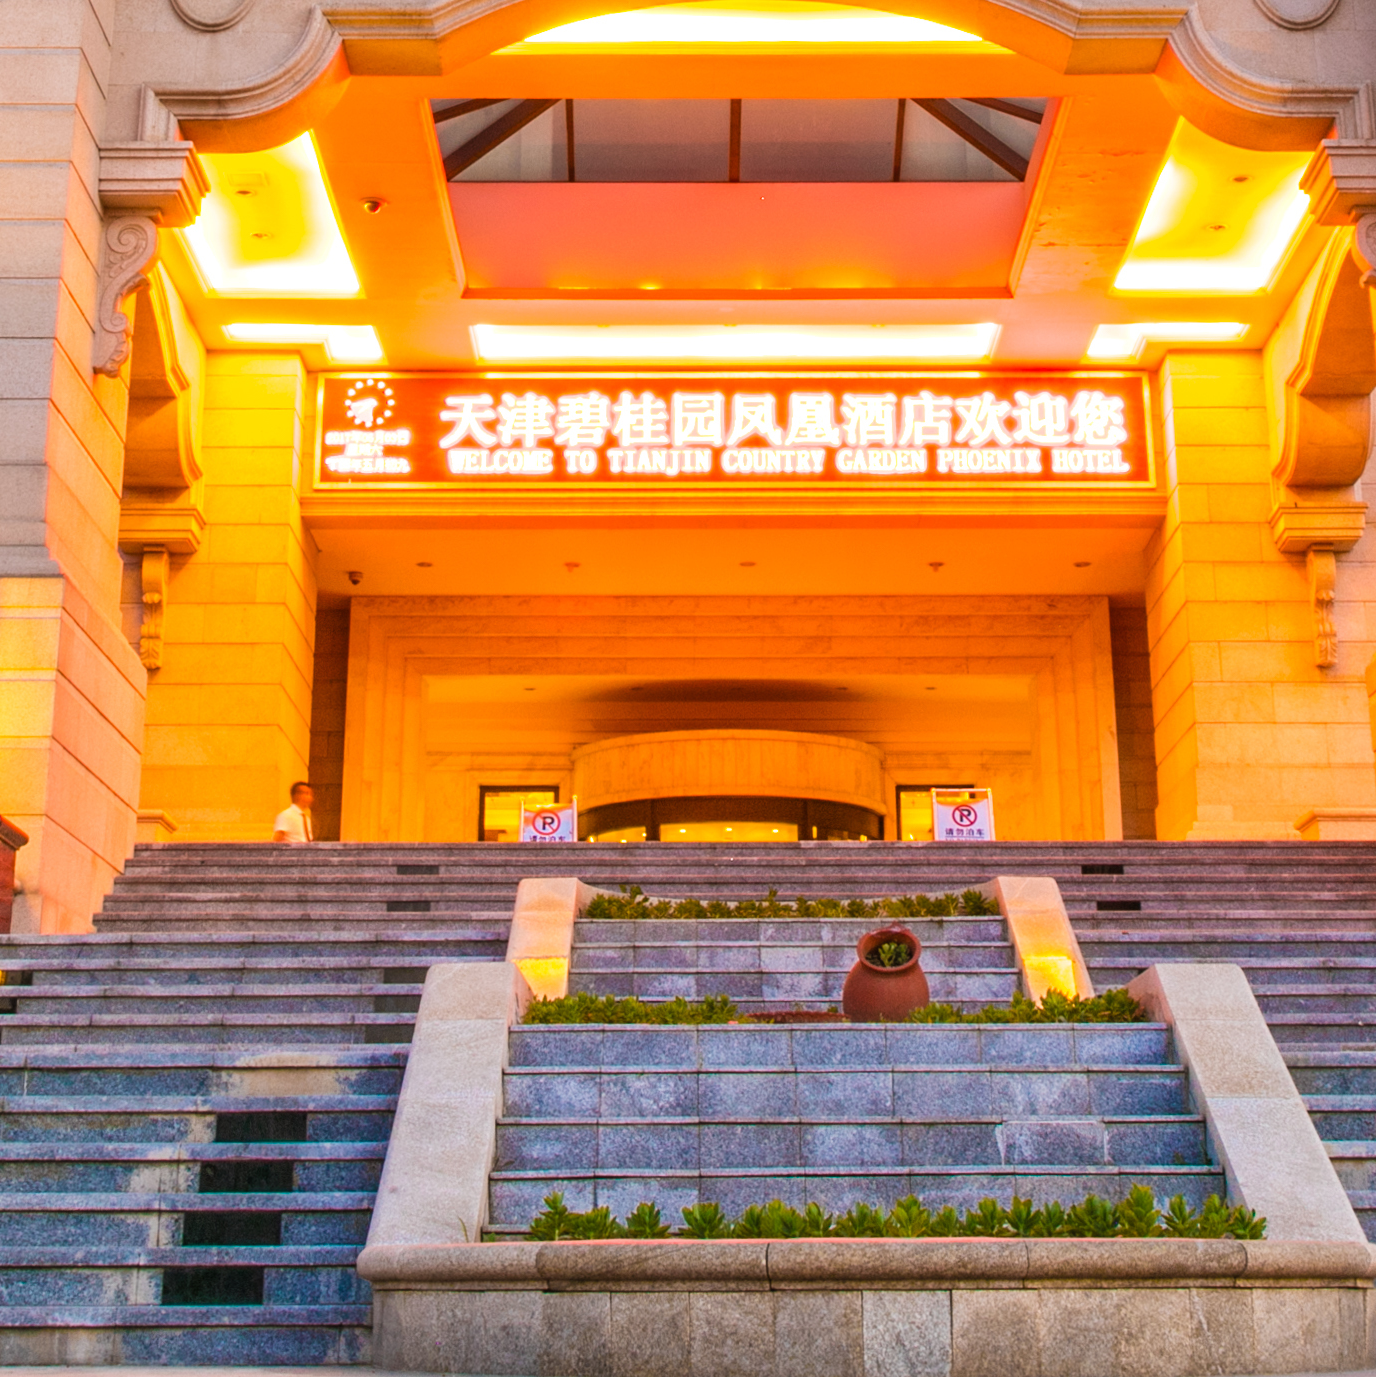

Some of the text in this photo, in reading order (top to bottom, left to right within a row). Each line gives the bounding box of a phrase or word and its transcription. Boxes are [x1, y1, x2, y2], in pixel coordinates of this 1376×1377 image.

[439, 391, 1127, 448] 天津碧桂园凤凰酒店欢迎您
[449, 449, 1129, 474] WELCOME TO TIANJIN COUNTRY GARDEN PHOENIX HOTEL
